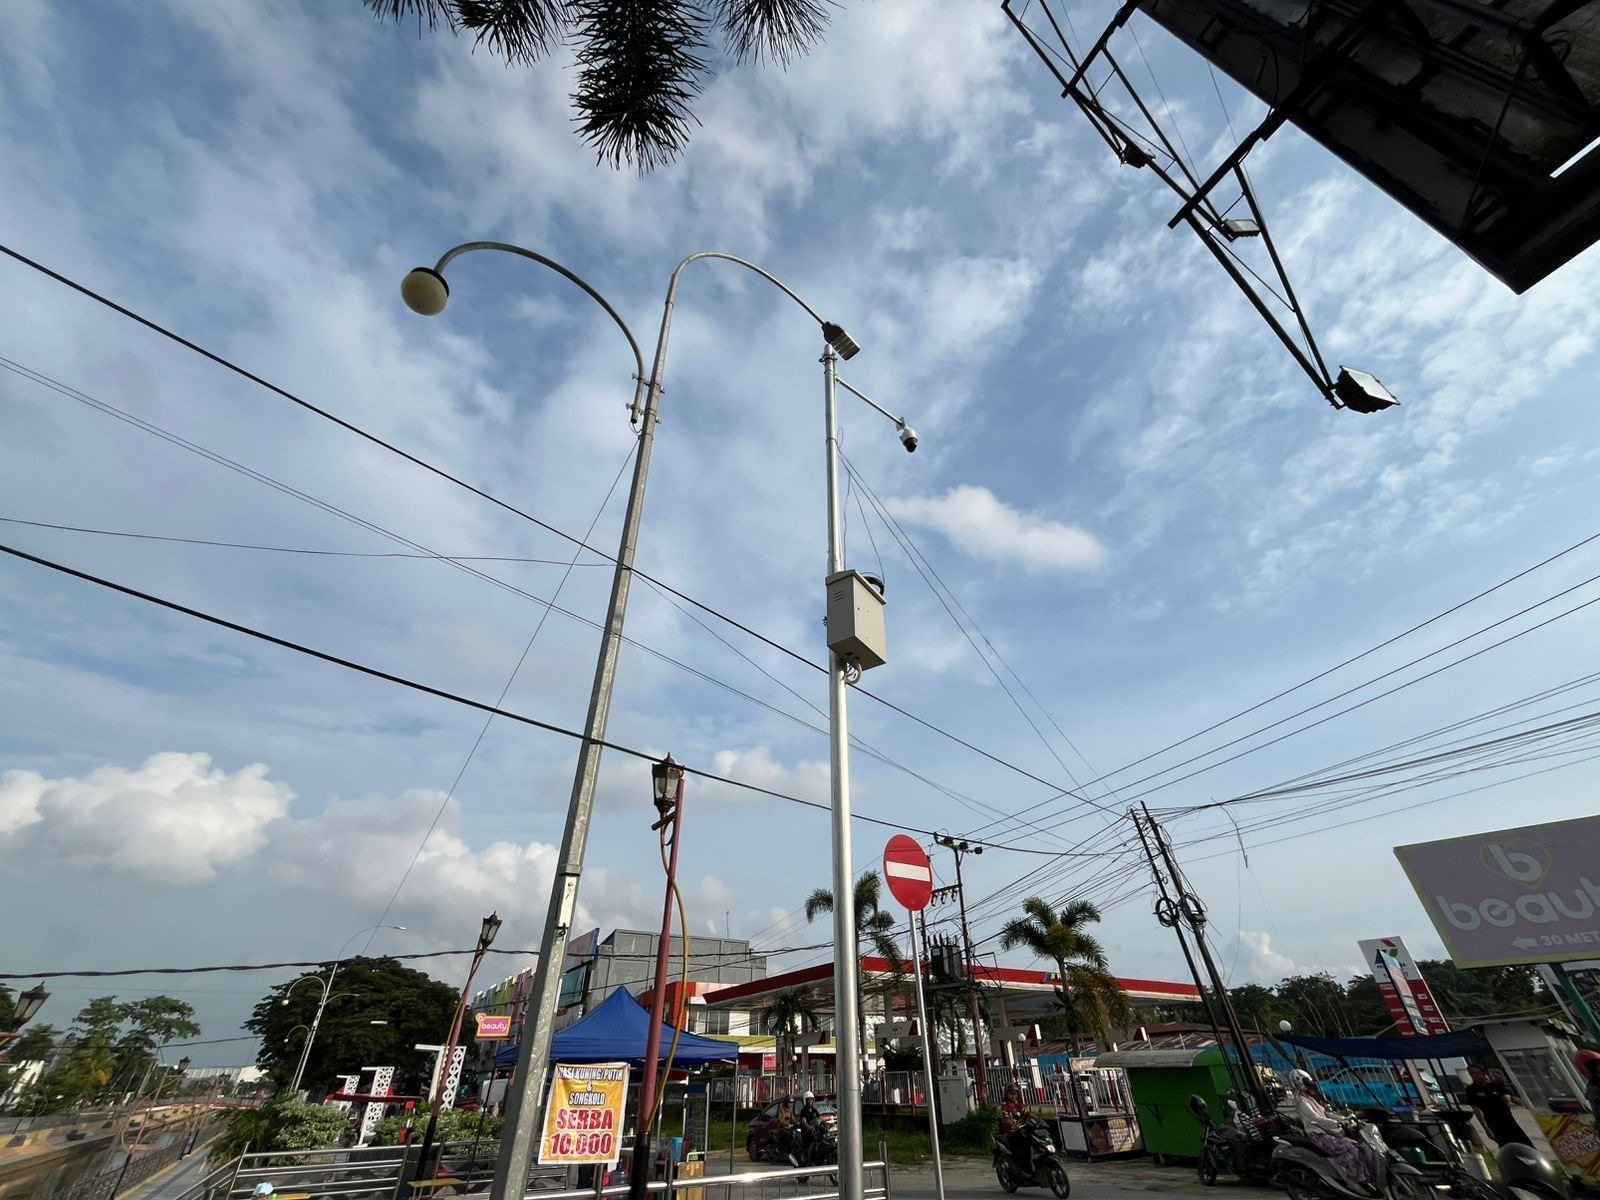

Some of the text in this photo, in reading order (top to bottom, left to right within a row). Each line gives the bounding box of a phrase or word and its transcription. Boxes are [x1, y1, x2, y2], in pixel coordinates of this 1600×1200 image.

[1487, 843, 1543, 882] b
[1540, 933, 1563, 946] 30
[481, 1022, 507, 1032] beauty
[587, 1081, 592, 1091] &
[569, 1092, 606, 1105] SONGKOLO
[556, 1109, 613, 1130] SERBA
[551, 1132, 613, 1155] 10.000
